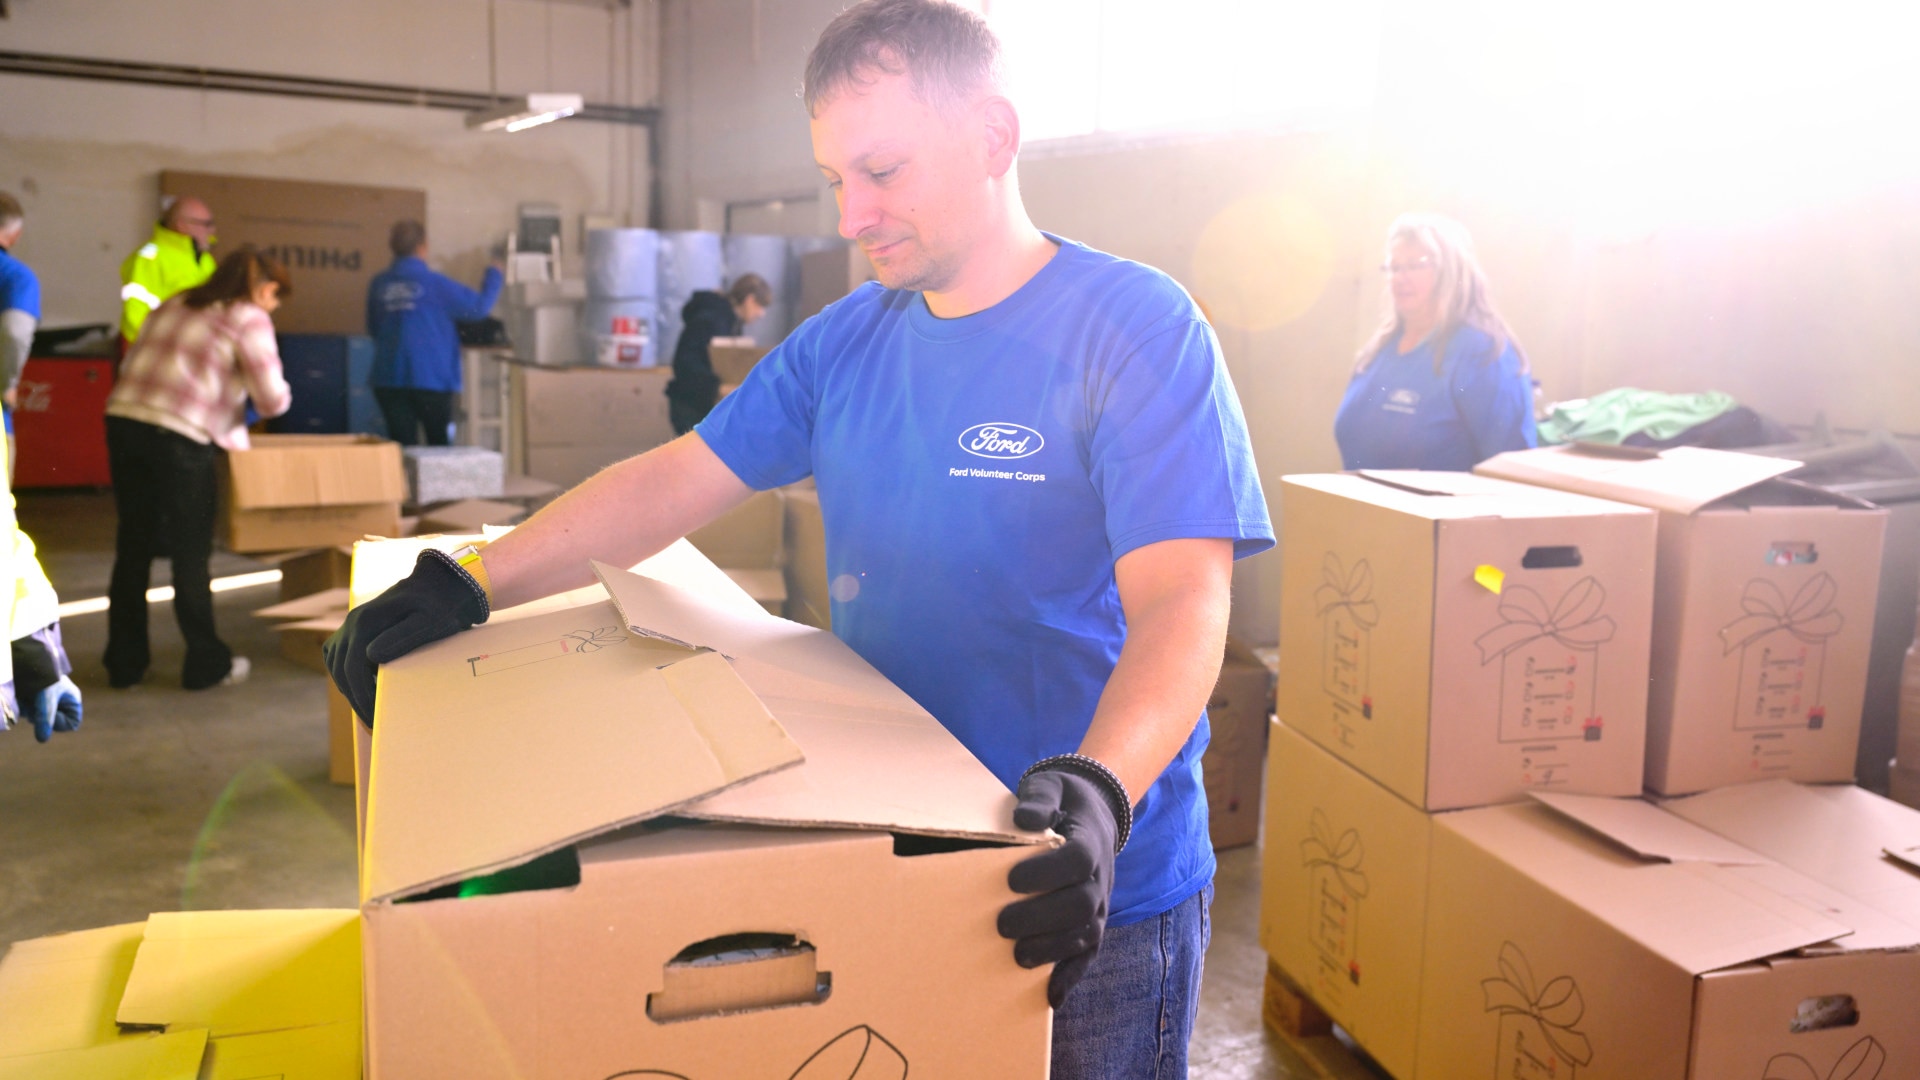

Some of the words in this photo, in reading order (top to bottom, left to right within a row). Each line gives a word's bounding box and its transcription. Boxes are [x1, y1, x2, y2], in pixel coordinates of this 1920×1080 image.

[970, 426, 1031, 455] Ford
[949, 467, 969, 477] Ford
[969, 467, 1014, 480] Volunteer
[1015, 471, 1046, 483] Corps
